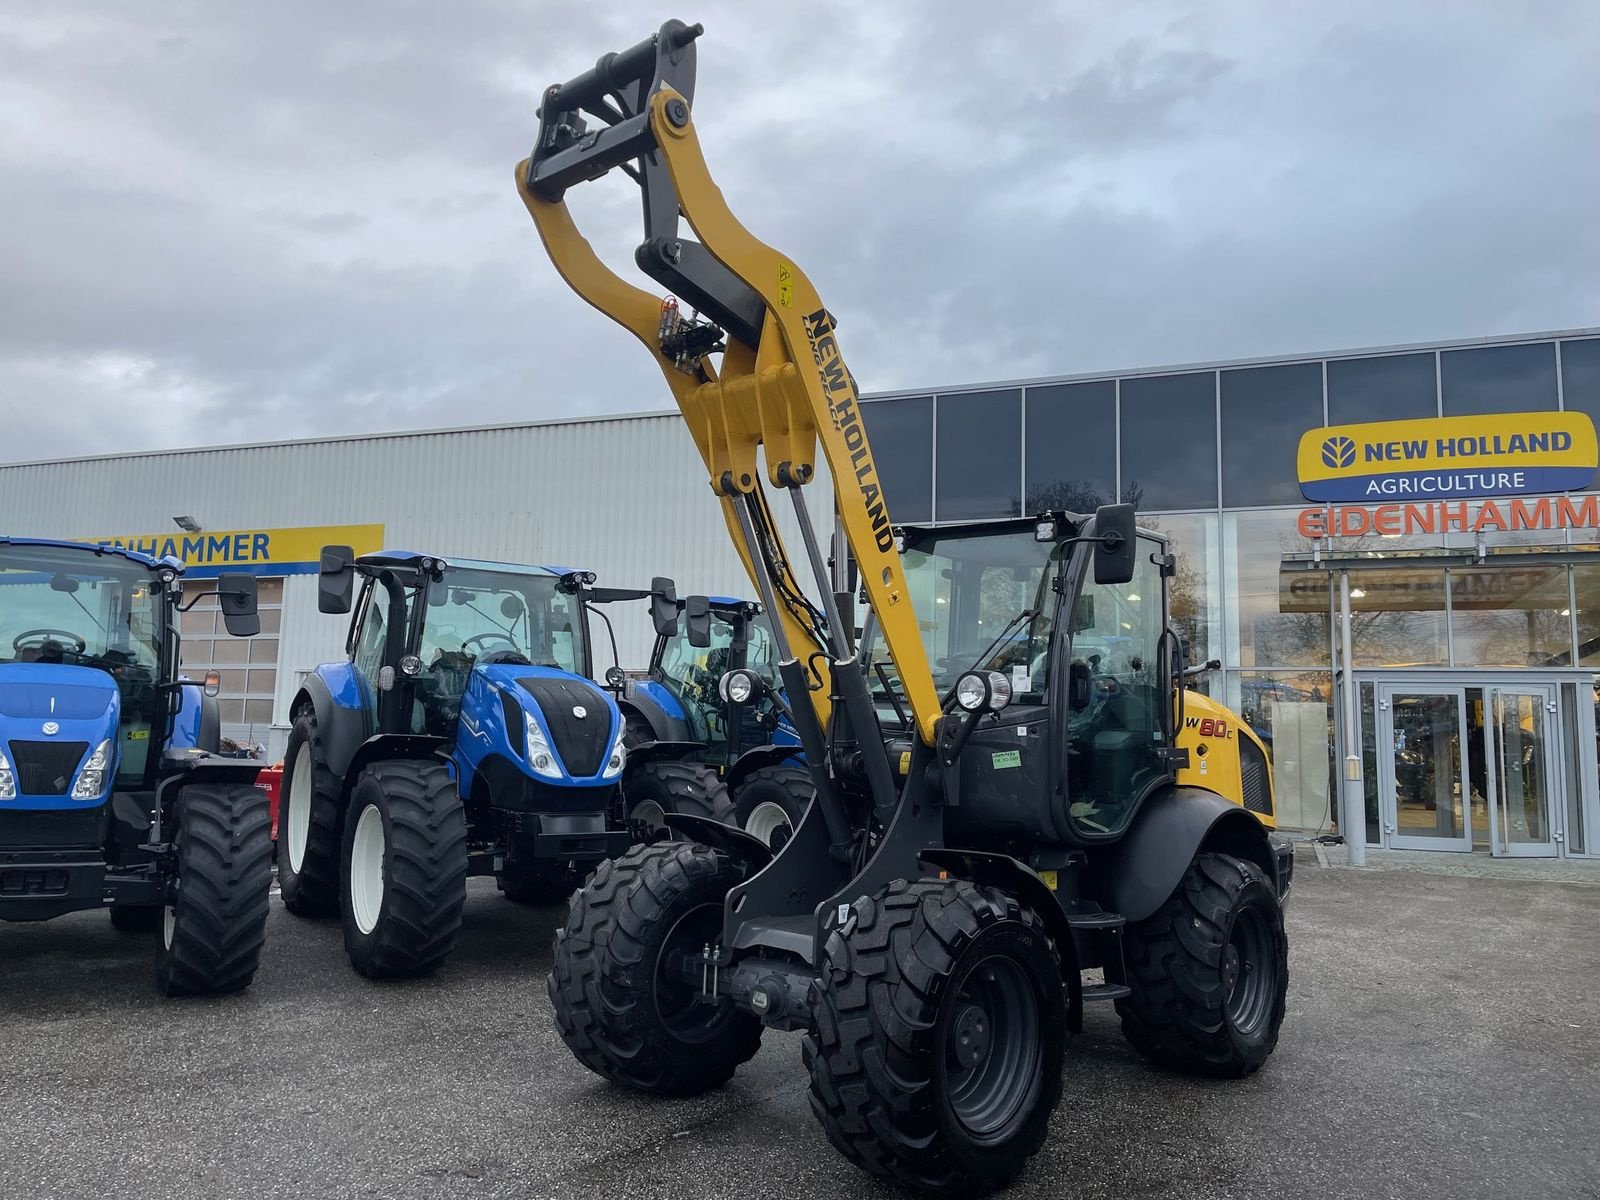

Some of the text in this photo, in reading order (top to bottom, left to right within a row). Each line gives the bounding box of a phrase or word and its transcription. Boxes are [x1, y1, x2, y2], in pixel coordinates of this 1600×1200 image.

[802, 315, 841, 432] LONG REACH
[808, 308, 894, 555] NEW HOLLAND
[1364, 431, 1572, 462] NEW HOLLAND
[1365, 472, 1526, 496] AGRICULTURE
[1297, 496, 1600, 538] EIDENHAMM
[98, 533, 270, 563] HAMMER
